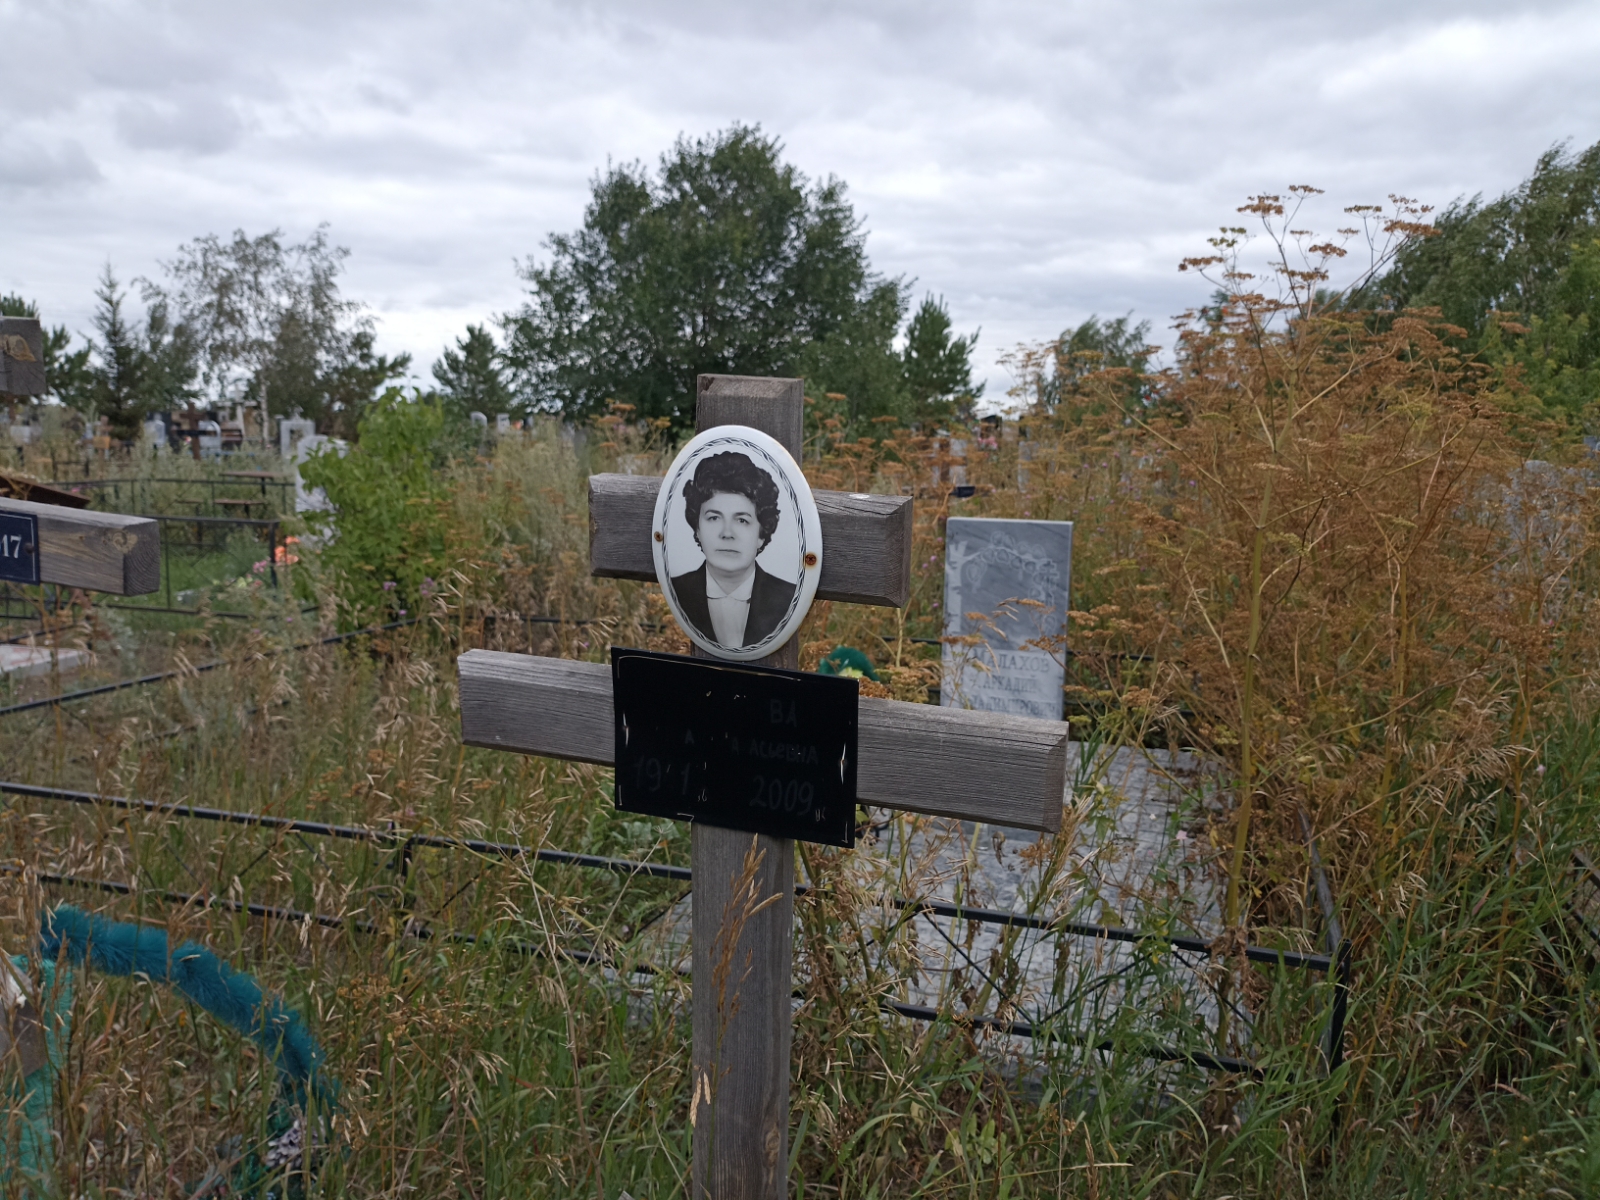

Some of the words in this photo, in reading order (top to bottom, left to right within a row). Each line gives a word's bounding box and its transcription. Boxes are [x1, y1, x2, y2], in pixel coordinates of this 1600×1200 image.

[0, 534, 22, 559] 17
[633, 754, 691, 795] 191
[749, 775, 814, 816] 2009
